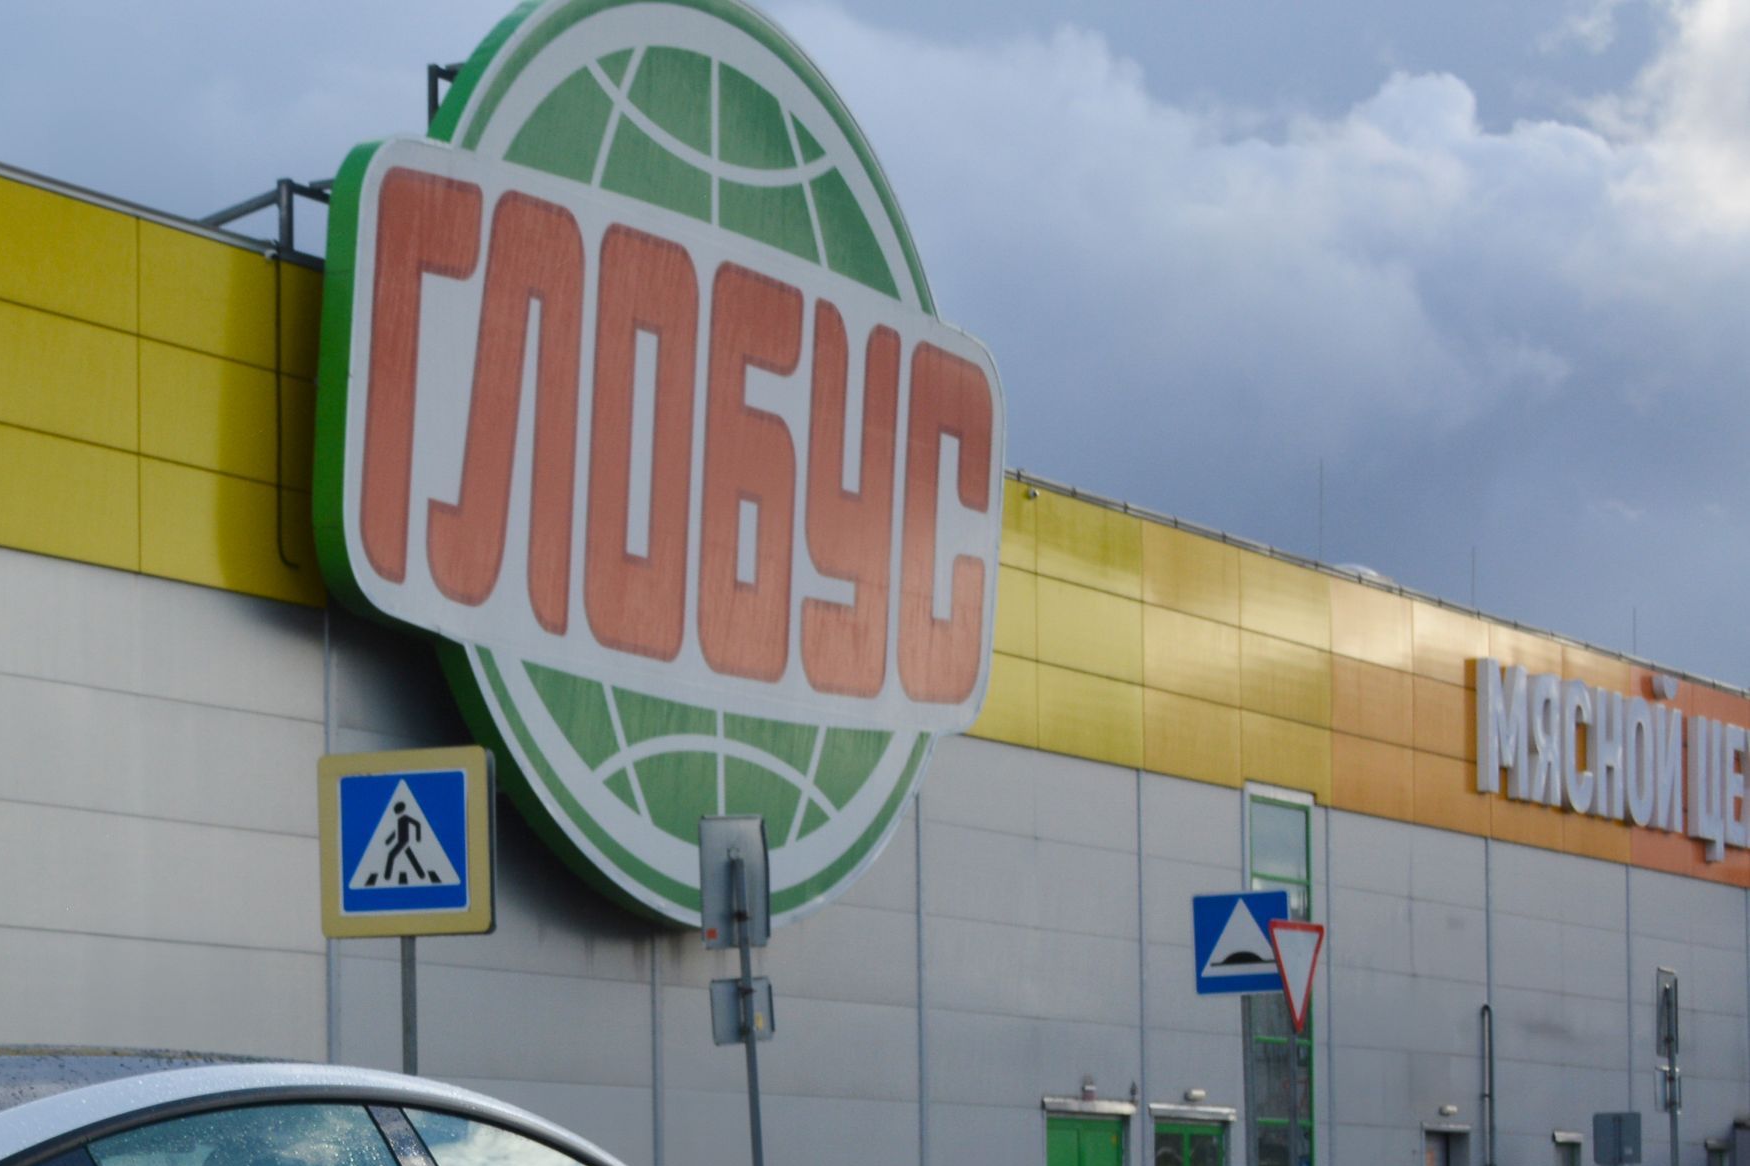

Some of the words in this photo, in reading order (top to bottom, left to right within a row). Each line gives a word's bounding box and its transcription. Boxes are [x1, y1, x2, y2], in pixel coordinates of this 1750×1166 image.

[360, 165, 994, 705] ГЛОБУС
[1476, 657, 1683, 833] МЯСНОЙ
[1688, 714, 1750, 862] ЦЕ
